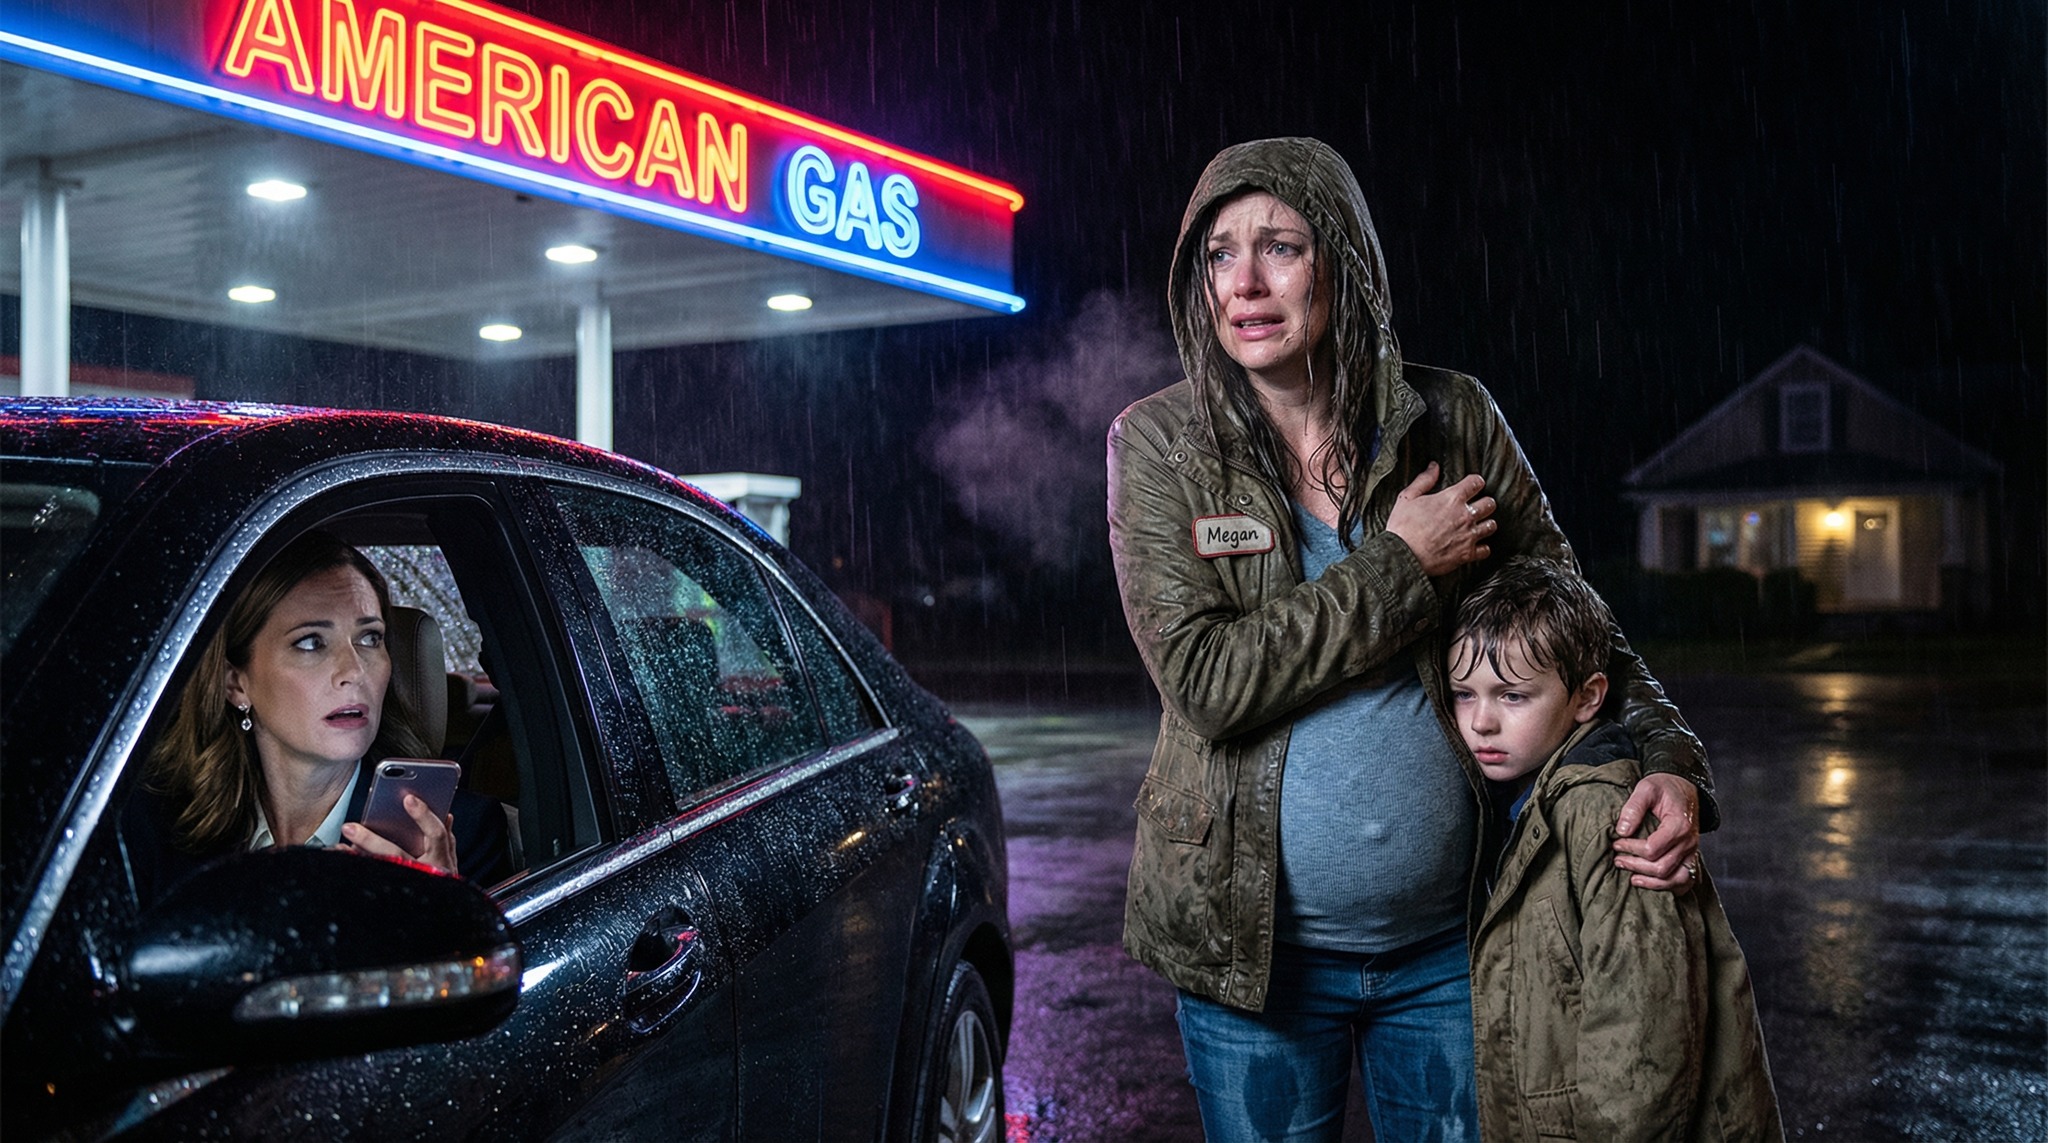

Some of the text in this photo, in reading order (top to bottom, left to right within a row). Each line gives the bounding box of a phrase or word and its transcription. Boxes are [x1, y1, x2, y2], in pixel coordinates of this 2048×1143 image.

[225, 0, 921, 258] AMERICAN GAS
[1207, 526, 1259, 549] Megan
